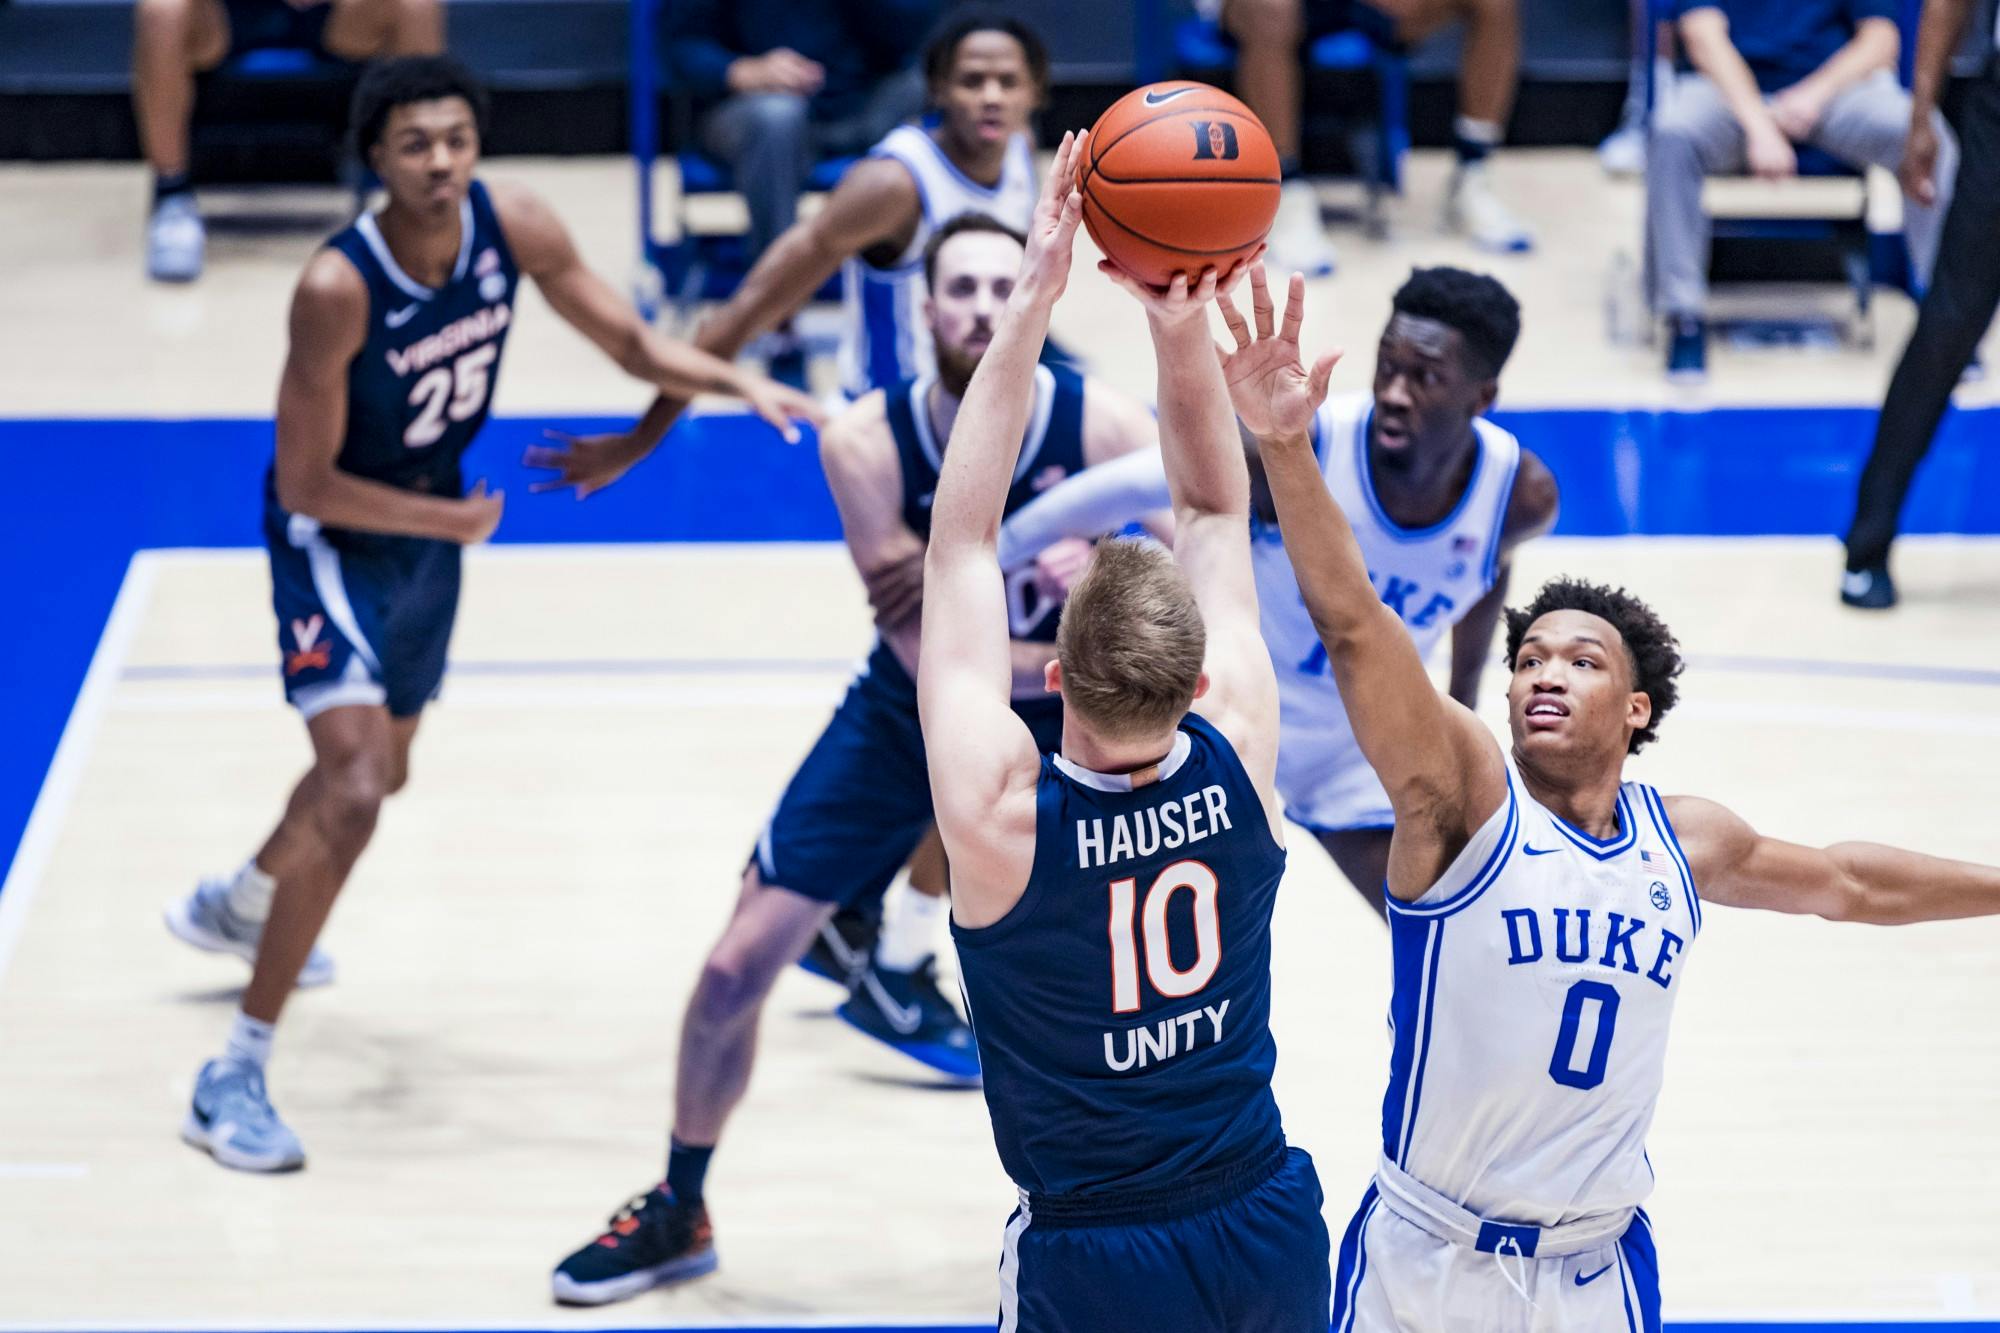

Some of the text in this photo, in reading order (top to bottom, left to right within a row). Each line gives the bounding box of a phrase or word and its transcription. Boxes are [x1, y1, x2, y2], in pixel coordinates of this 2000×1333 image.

[404, 343, 497, 447] 25
[1076, 784, 1232, 868] HAUSER
[1108, 859, 1222, 1014] 10
[1501, 908, 1684, 989] DUKE
[1103, 999, 1230, 1072] UNITY
[1548, 979, 1620, 1090] 0
